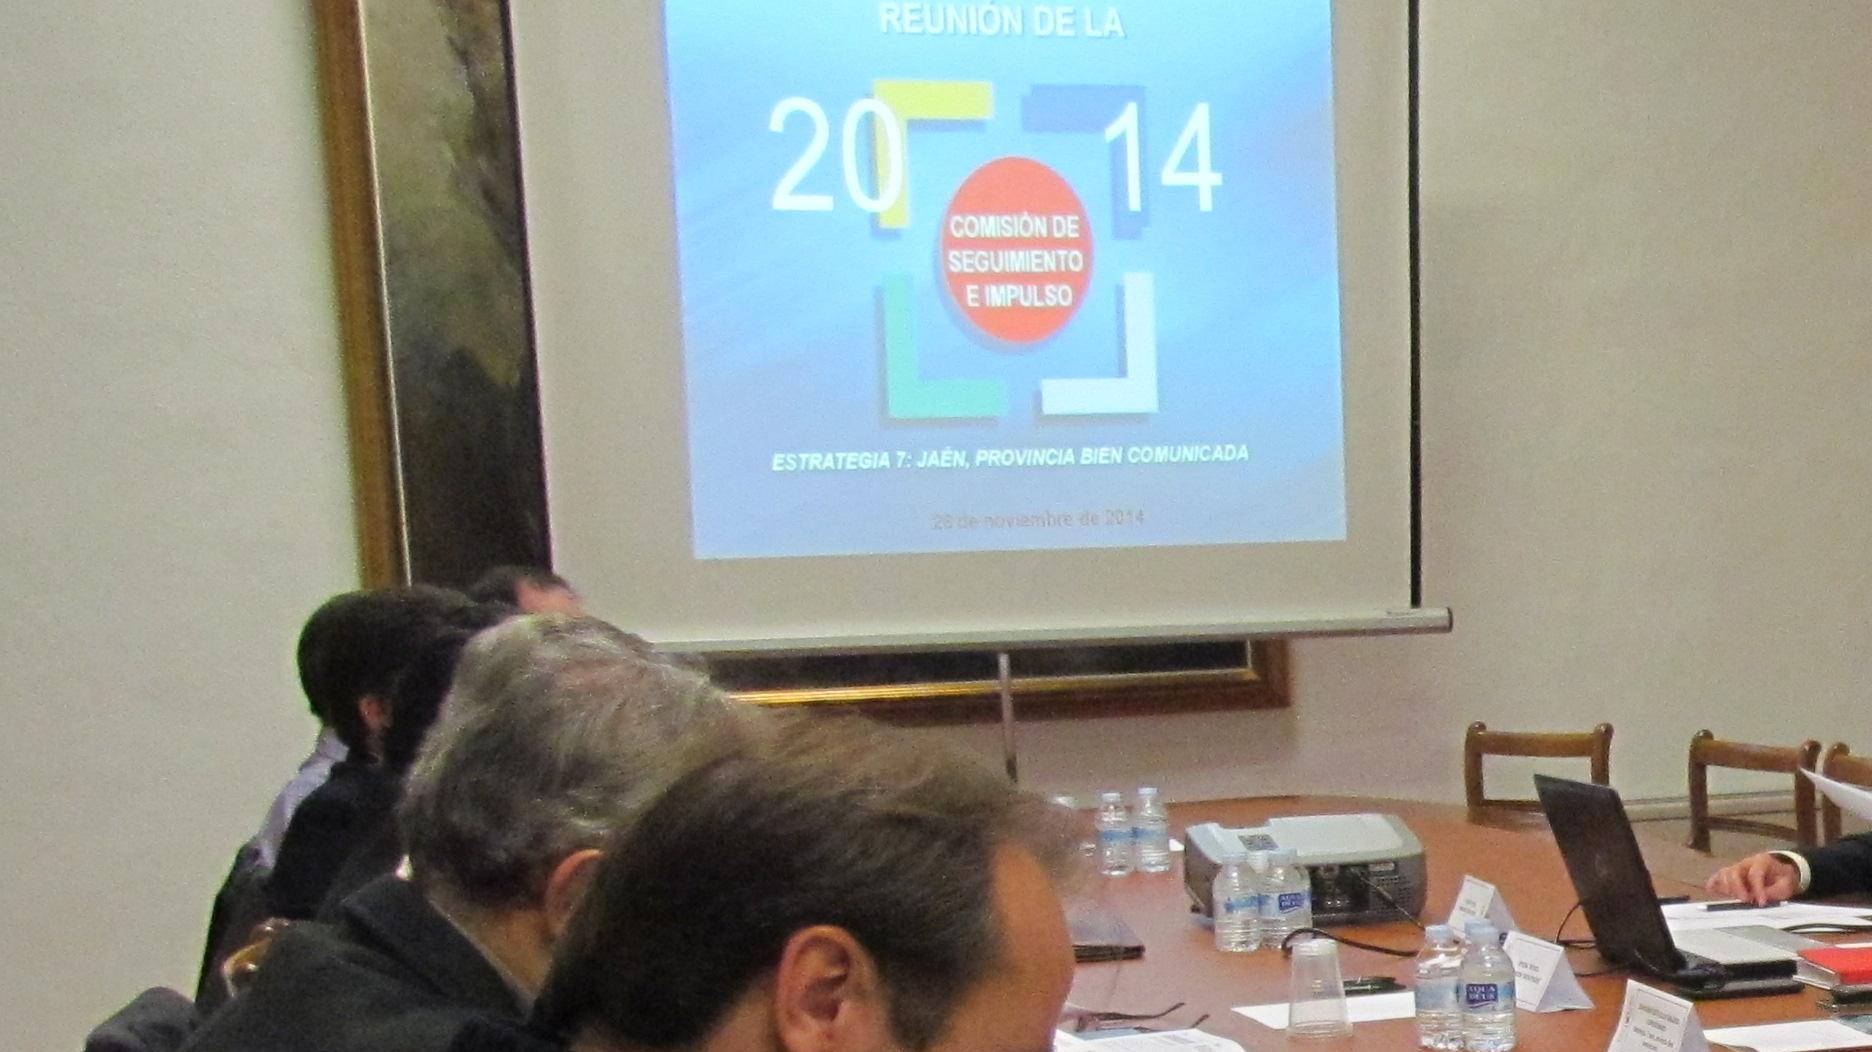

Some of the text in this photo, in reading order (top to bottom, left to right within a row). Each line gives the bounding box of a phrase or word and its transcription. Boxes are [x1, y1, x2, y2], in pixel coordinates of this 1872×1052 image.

[879, 2, 1127, 39] REUNIÓN DE LA
[768, 96, 1224, 213] 20 14
[949, 210, 1080, 239] COMISIÓN DE
[948, 249, 1084, 274] SEGUIMIENTO
[966, 283, 1074, 307] E IMPULSO
[772, 443, 1249, 472] ESTRATEGIA 7: JAÉN, PROVINCIA BIEN COMUNICADA
[957, 512, 979, 529] de
[984, 509, 1073, 528] noviembre
[1079, 510, 1100, 526] de
[1105, 507, 1145, 526] 2014
